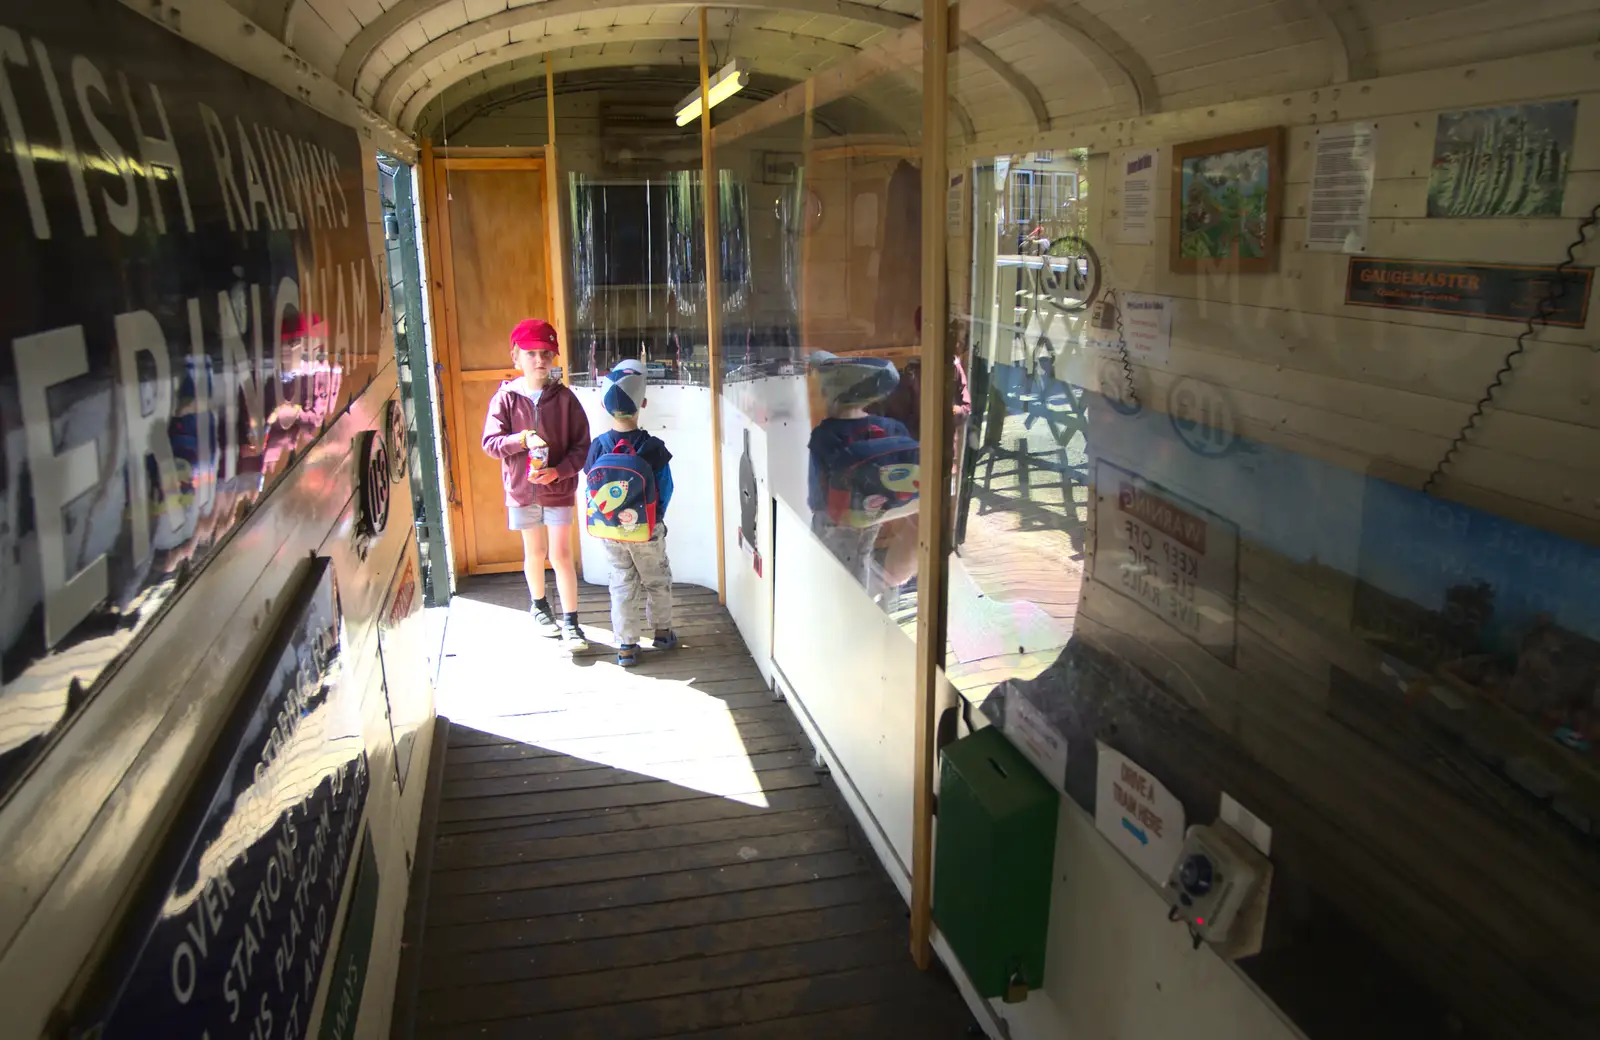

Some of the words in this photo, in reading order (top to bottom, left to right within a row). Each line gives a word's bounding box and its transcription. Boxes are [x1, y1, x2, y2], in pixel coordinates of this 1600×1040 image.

[198, 101, 349, 232] RAILWAYS
[1360, 268, 1480, 290] GAUGEMASTER
[171, 854, 235, 1005] OVER
[223, 823, 298, 1024] STATIONS
[275, 799, 331, 993] PLATFORM
[304, 903, 326, 1004] AND
